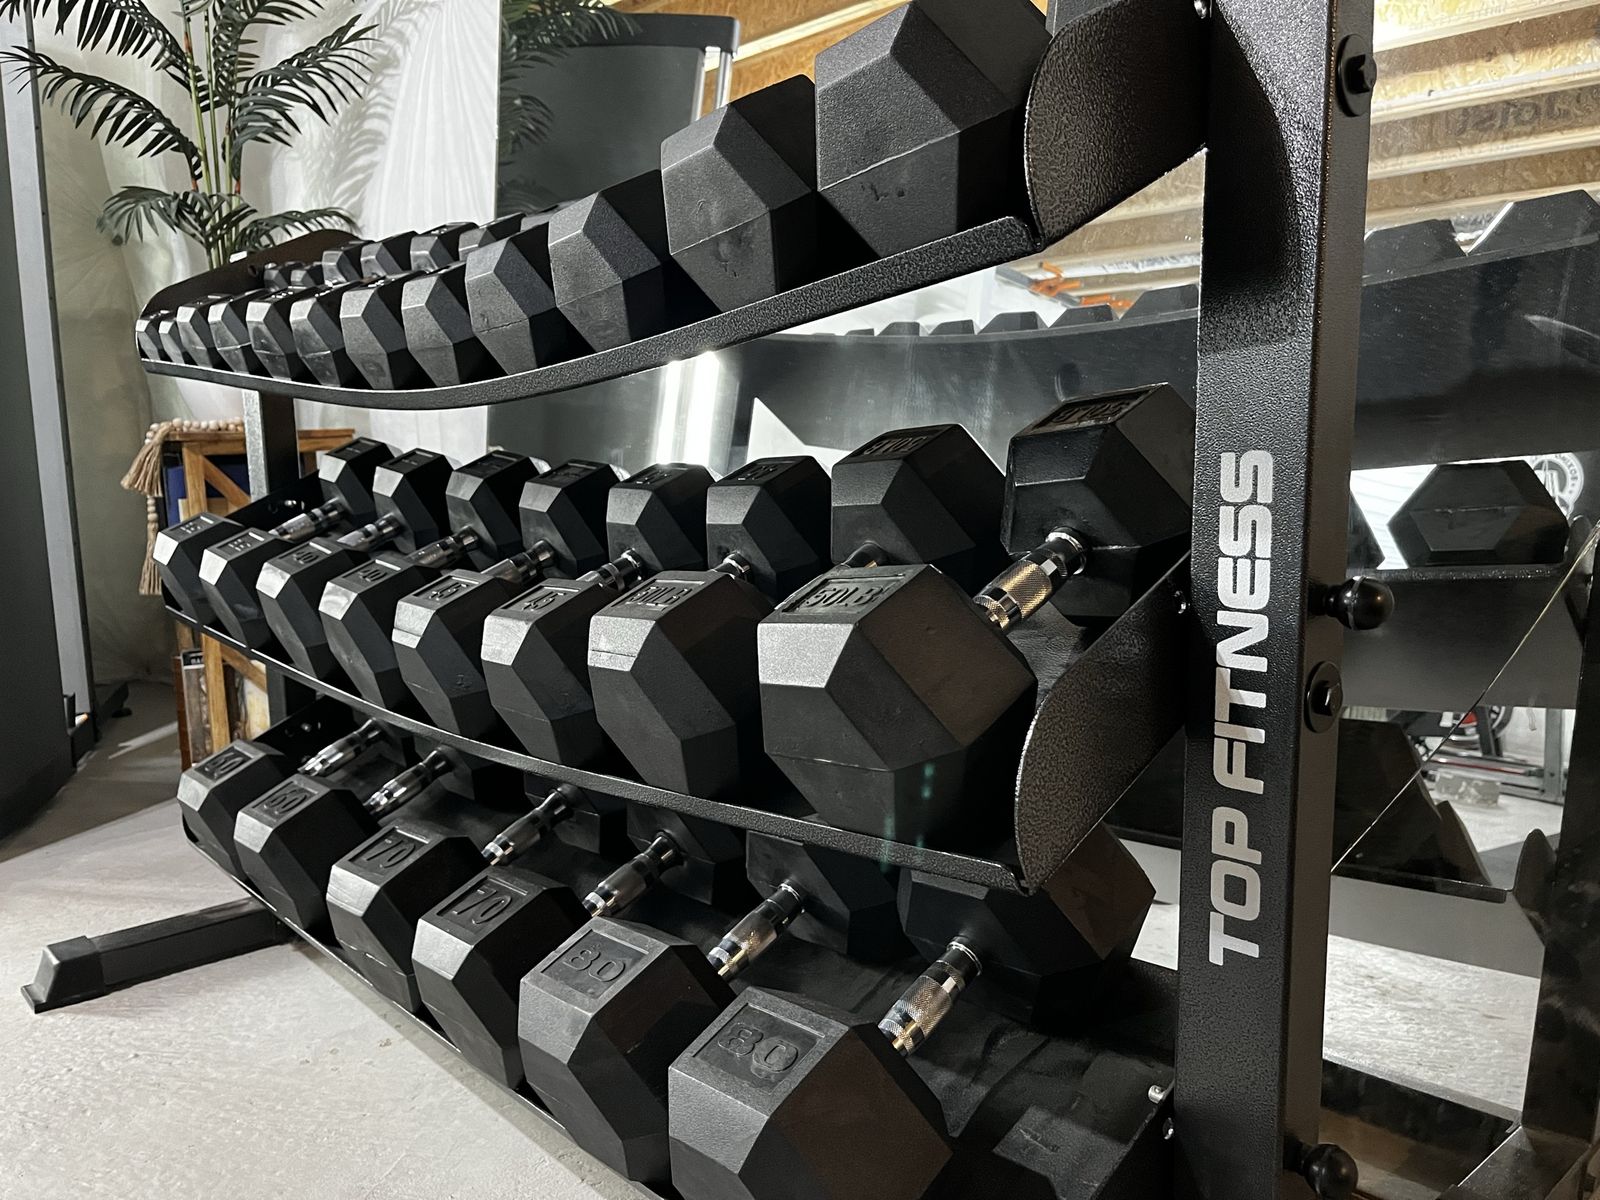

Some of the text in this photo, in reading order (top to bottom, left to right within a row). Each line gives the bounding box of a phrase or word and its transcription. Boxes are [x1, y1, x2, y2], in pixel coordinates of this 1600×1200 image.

[1209, 449, 1274, 966] TOP FITNESS
[361, 834, 416, 869] 70
[451, 883, 513, 925] 70
[563, 947, 626, 983] 80
[717, 1021, 799, 1073] 80
